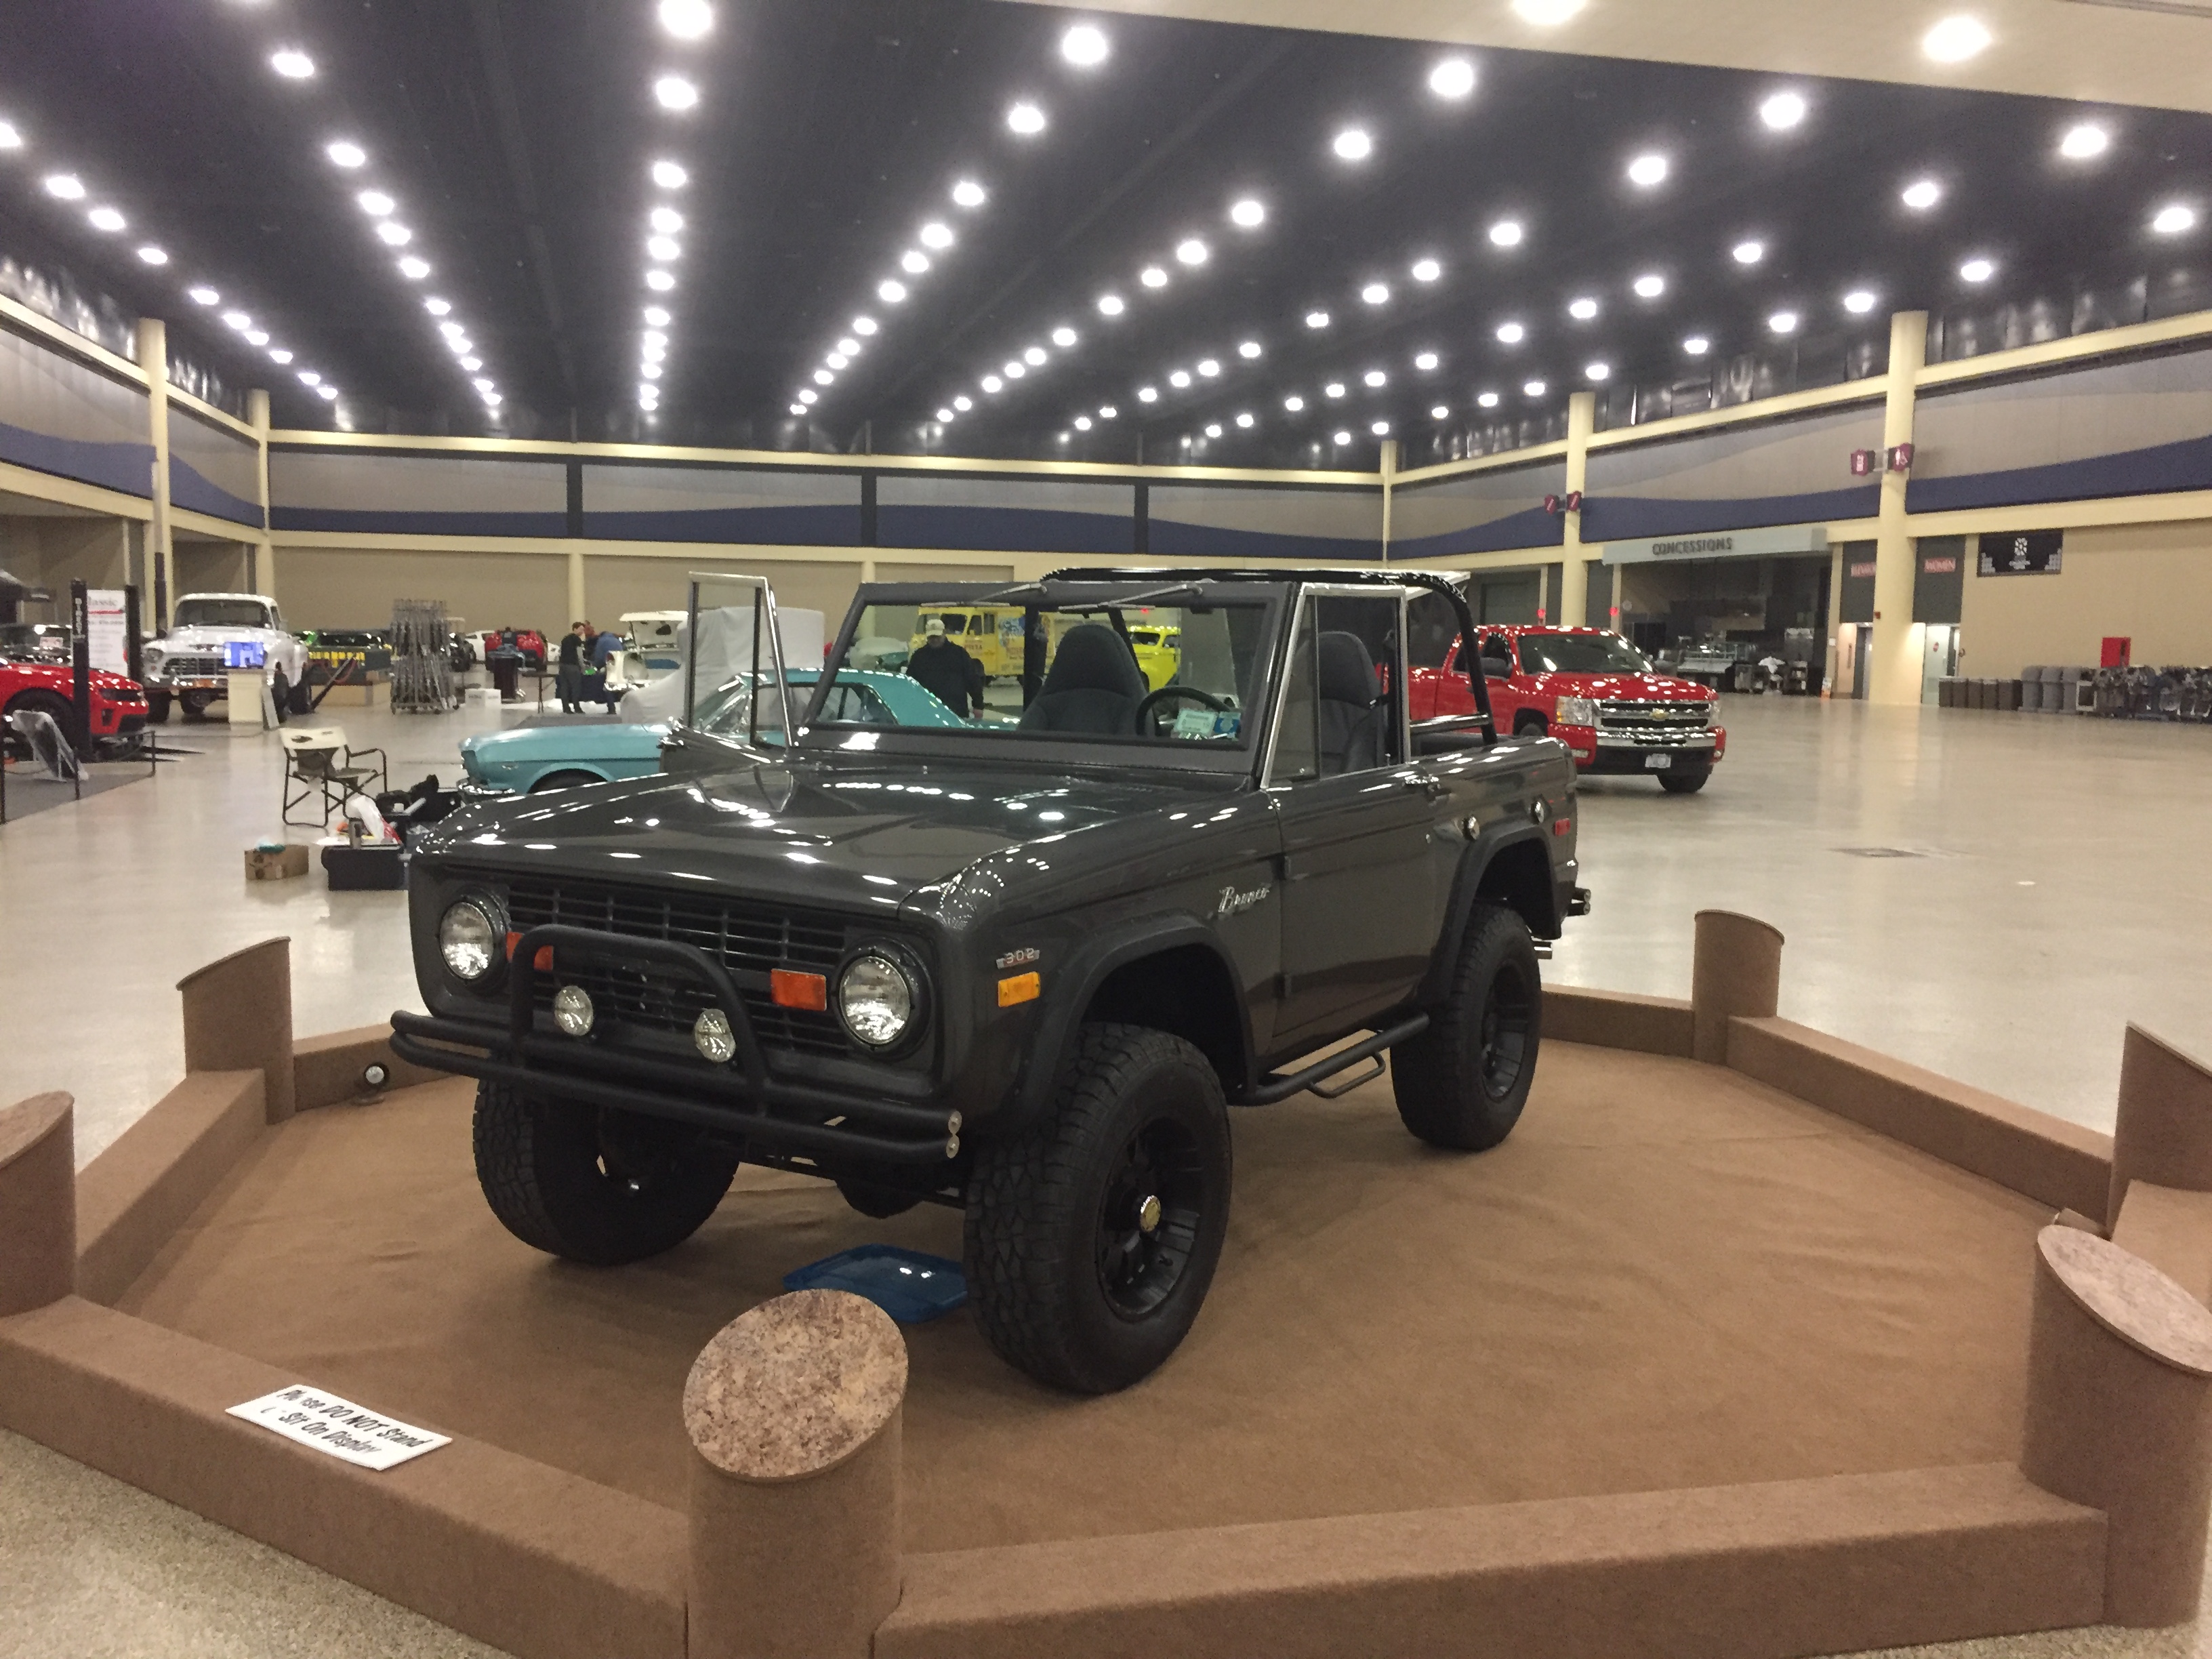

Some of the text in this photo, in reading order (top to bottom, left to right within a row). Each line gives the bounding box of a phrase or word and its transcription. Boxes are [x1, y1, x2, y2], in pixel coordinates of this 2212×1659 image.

[1652, 537, 1732, 555] CONCESSIONS
[1218, 886, 1270, 912] Bronco
[1005, 947, 1034, 964] 302
[279, 1412, 311, 1425] Sit
[301, 1422, 330, 1435] On
[319, 1405, 354, 1418] DO
[342, 1414, 390, 1432] NOT
[376, 1428, 434, 1448] Stand
